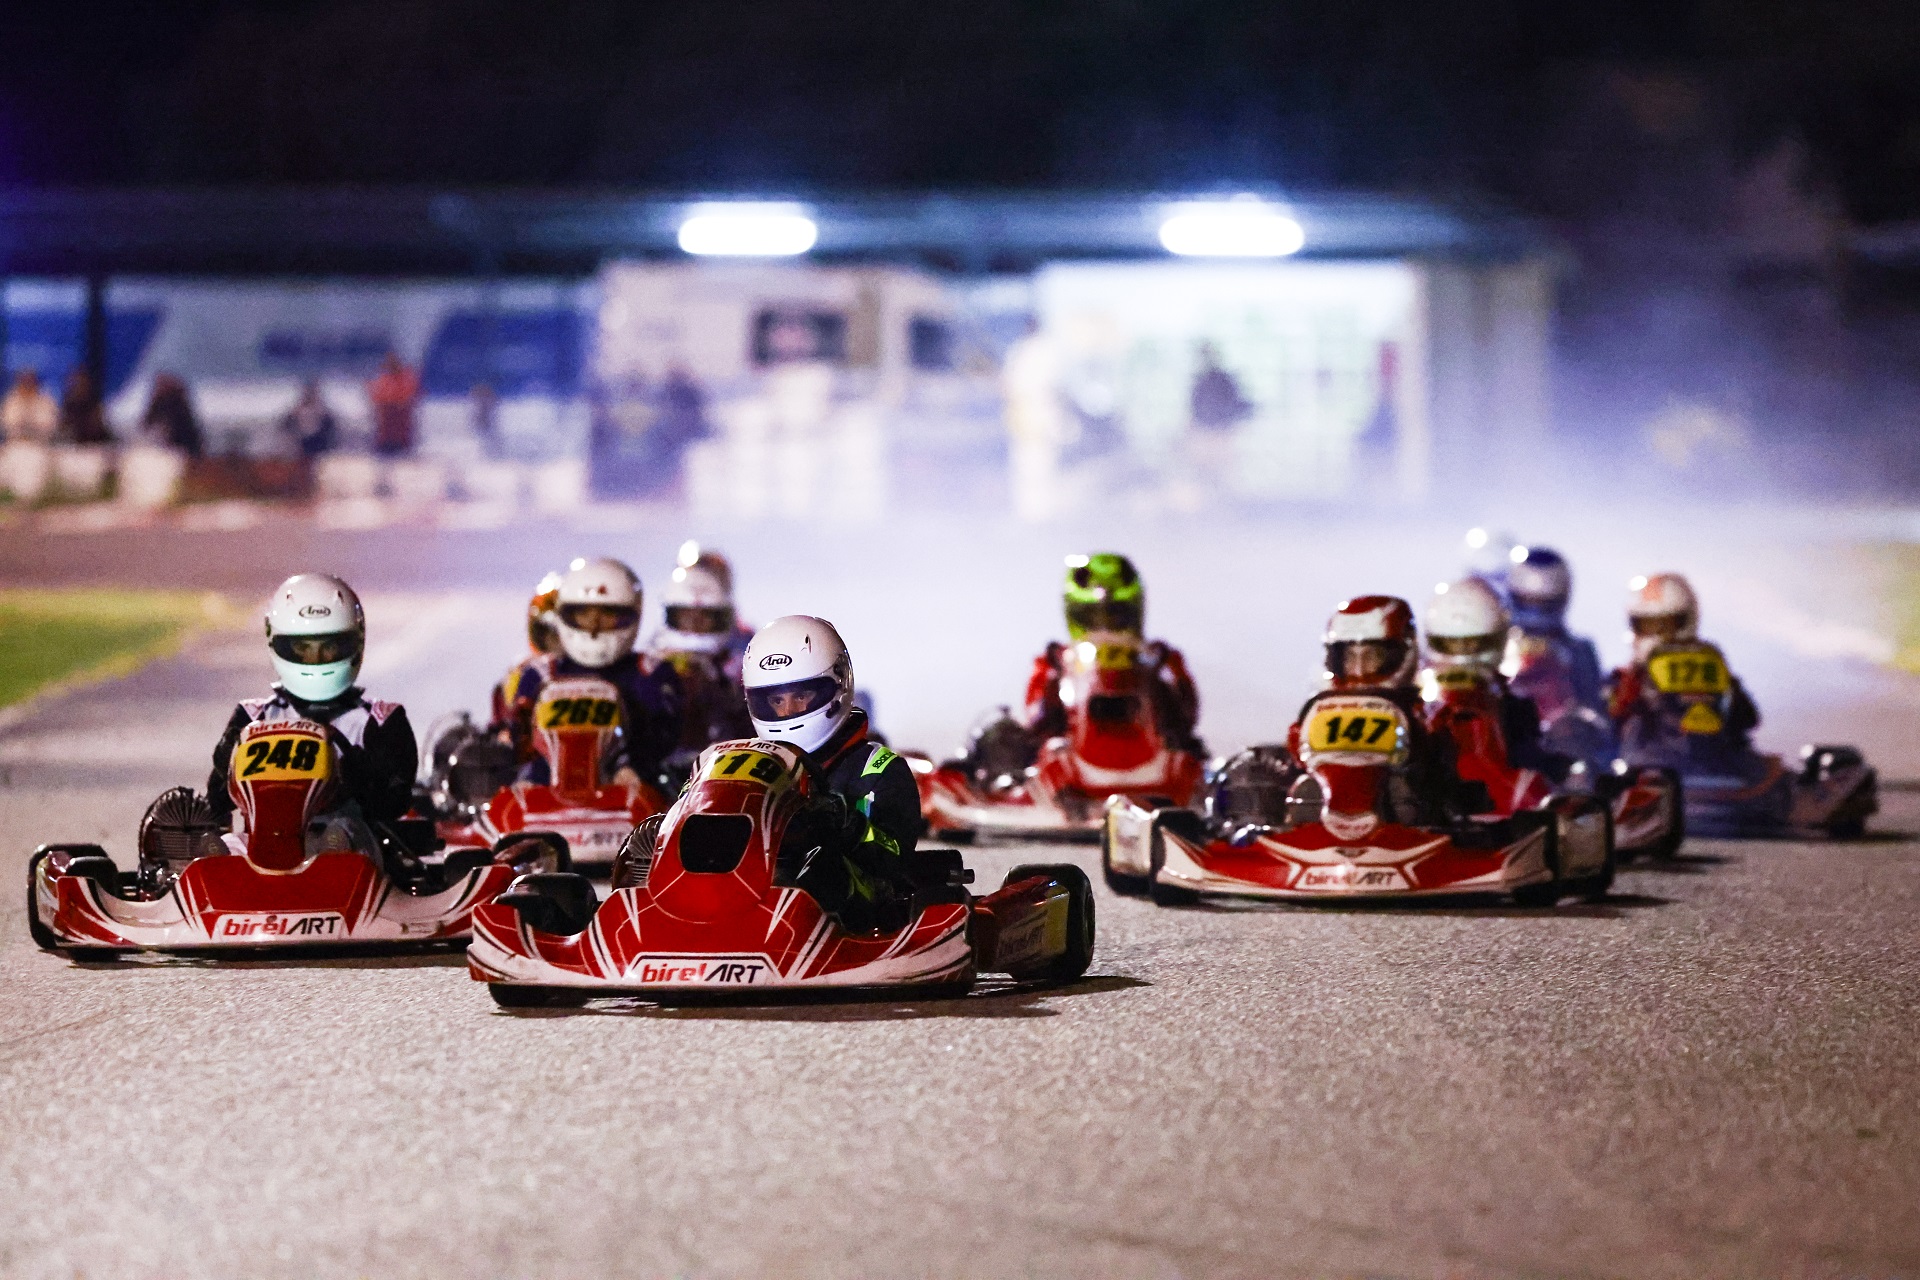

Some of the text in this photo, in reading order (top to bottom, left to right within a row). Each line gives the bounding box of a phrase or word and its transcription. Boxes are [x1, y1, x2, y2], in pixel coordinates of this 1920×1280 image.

[761, 655, 789, 668] Arai
[547, 698, 617, 727] 269
[1326, 716, 1391, 743] 147
[714, 741, 782, 752] birelART
[242, 739, 320, 777] 248
[223, 916, 341, 936] birelART
[641, 962, 764, 983] birelART
